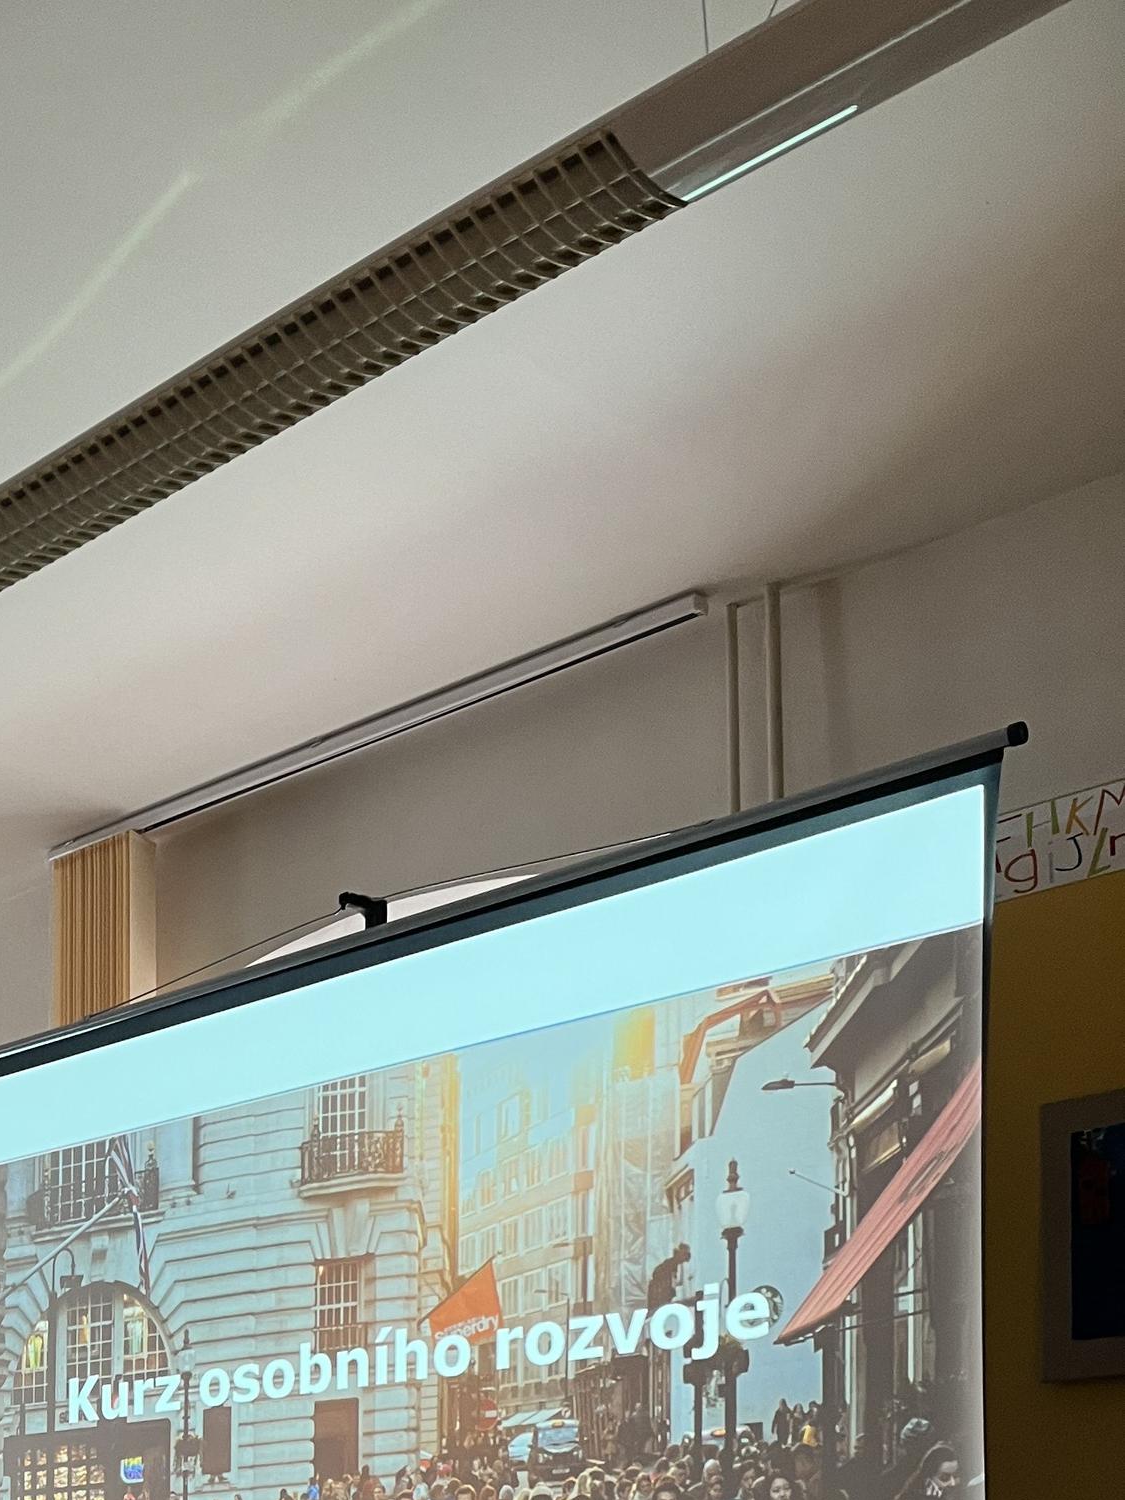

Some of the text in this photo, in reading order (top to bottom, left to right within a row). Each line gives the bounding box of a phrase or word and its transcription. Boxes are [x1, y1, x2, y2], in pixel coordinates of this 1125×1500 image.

[69, 1282, 770, 1424] Kurz osobního rozvoje
